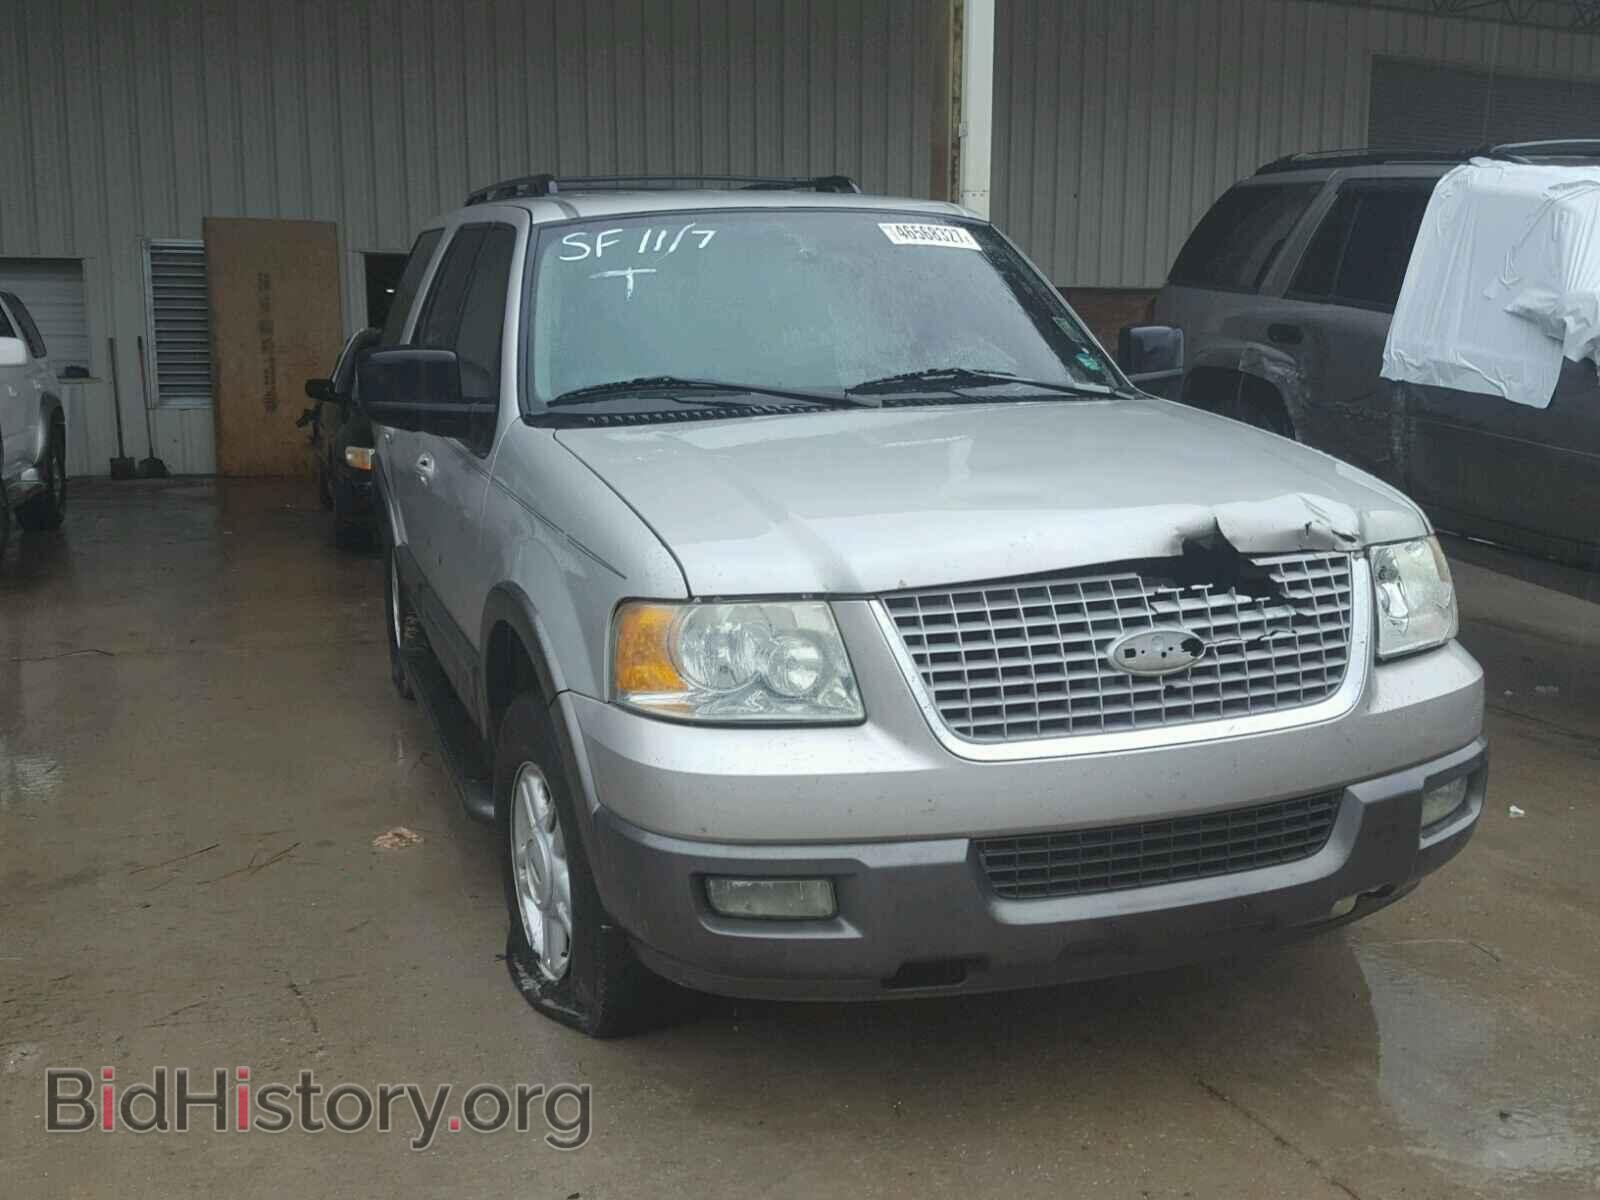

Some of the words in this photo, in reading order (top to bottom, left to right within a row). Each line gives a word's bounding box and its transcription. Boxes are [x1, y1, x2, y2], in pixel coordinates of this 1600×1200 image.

[559, 228, 624, 261] SF
[638, 223, 717, 261] 11/7
[894, 224, 964, 243] 46568327
[589, 267, 657, 300] T
